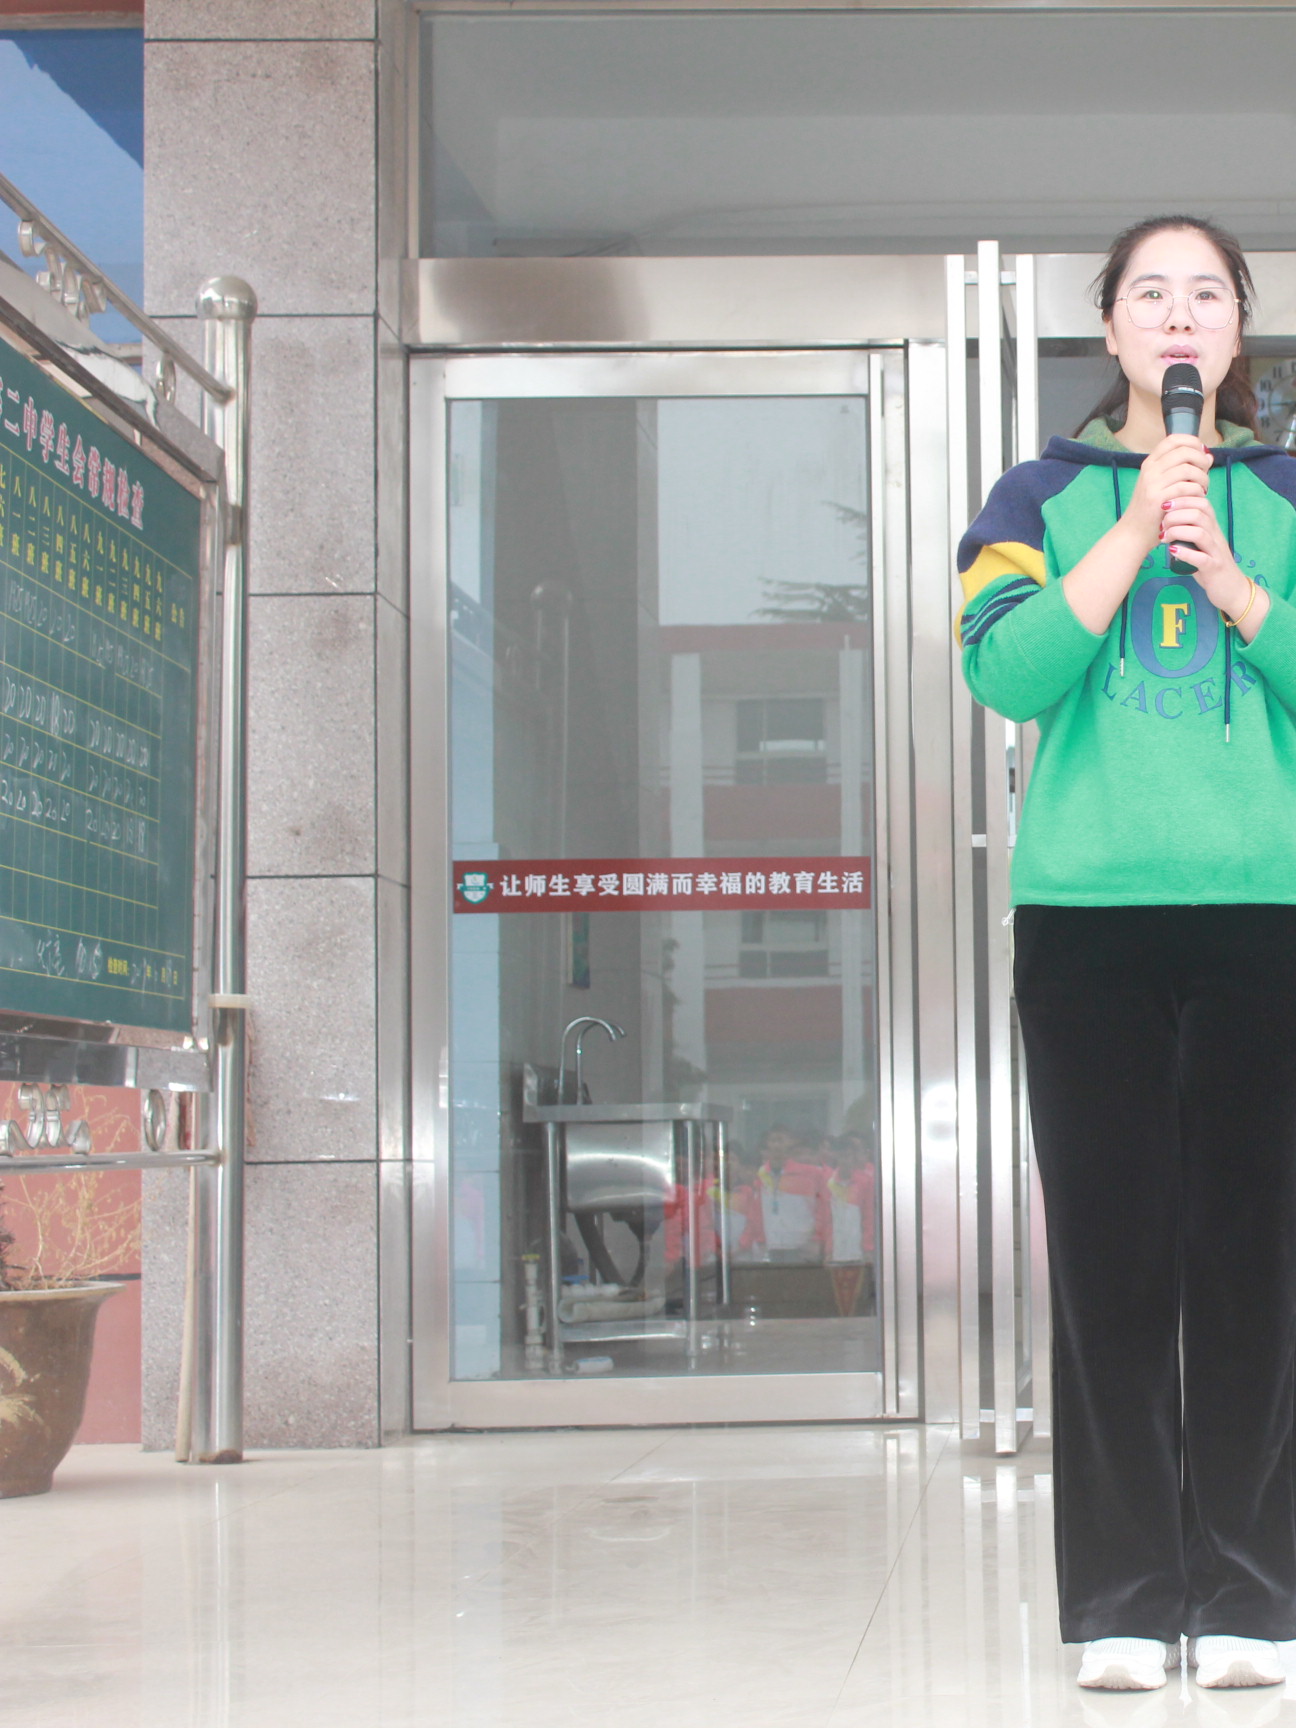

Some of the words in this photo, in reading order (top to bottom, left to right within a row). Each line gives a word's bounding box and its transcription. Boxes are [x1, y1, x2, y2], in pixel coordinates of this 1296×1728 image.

[0, 376, 144, 530] 二中学生会常规检查
[1159, 603, 1191, 648] F
[500, 872, 863, 898] 让师生享受圆满而幸福的教育生活
